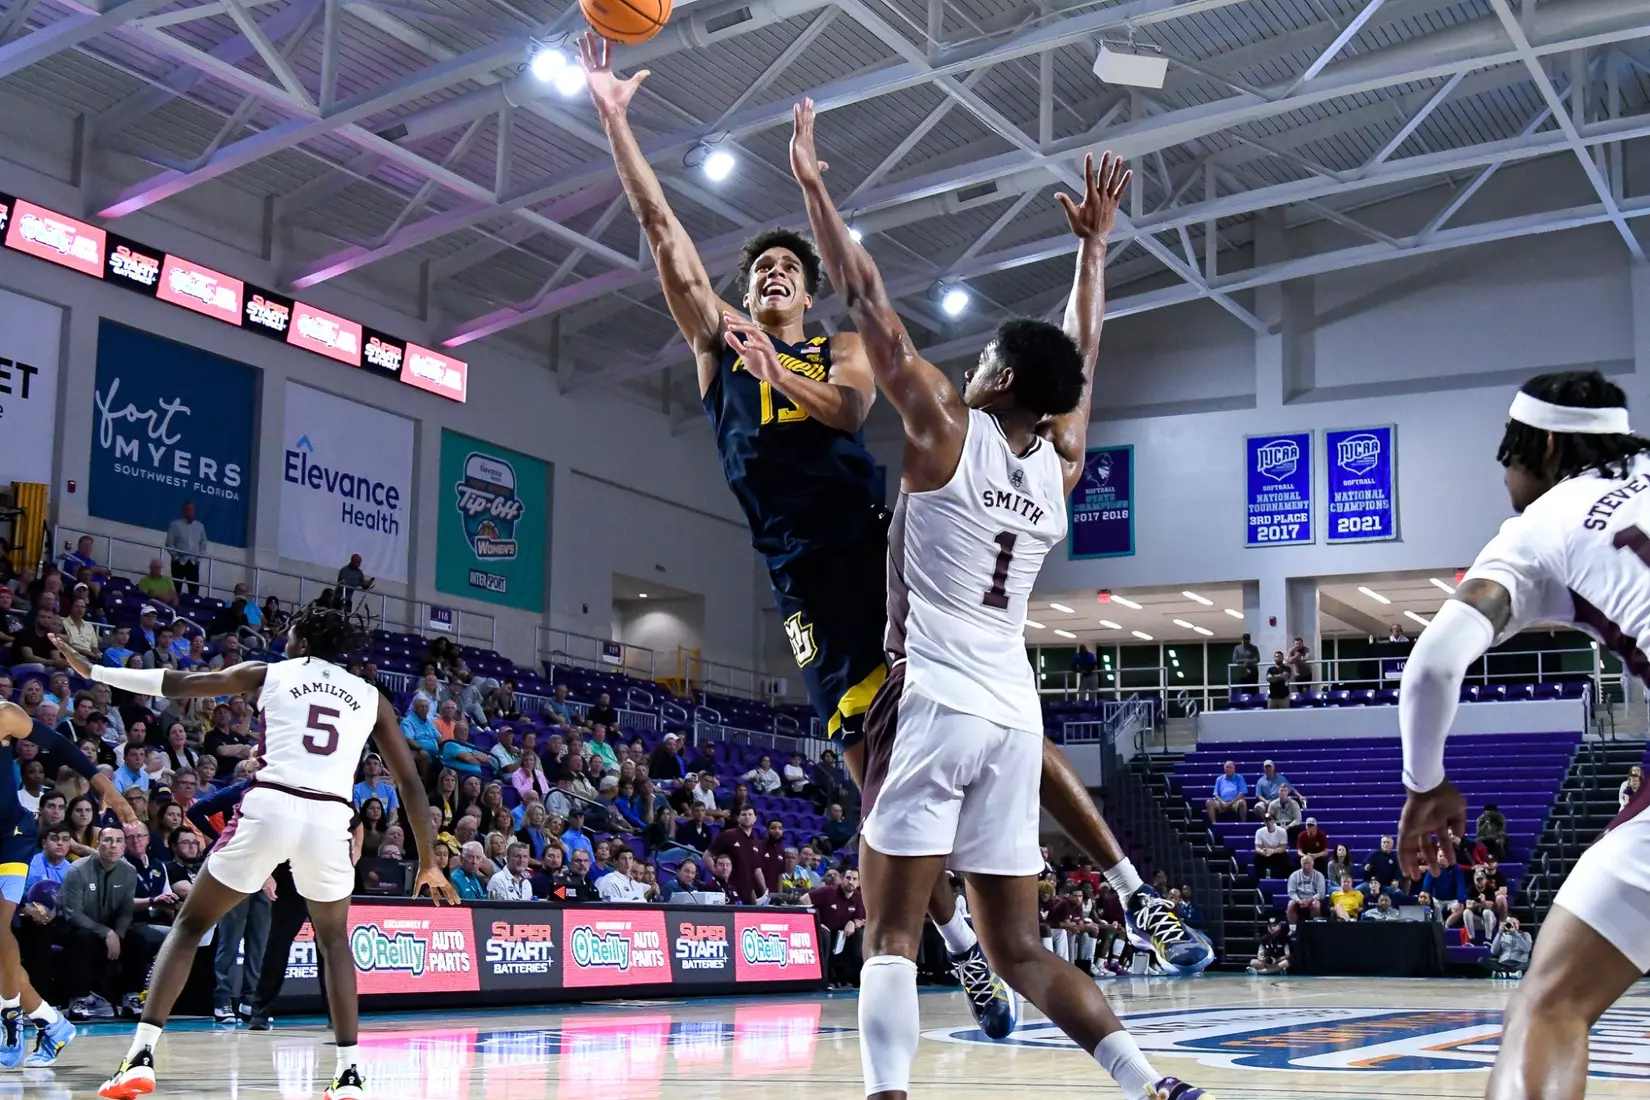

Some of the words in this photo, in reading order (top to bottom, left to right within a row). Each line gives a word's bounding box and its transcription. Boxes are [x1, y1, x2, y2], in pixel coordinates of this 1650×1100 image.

[109, 252, 159, 280] START
[246, 301, 289, 326] START
[115, 434, 242, 487] MYERS
[1257, 445, 1300, 472] NJCAA
[1338, 440, 1380, 466] NJCAA
[114, 463, 189, 488] SOUTHWEST
[193, 482, 240, 501] FLORIDA
[284, 450, 400, 510] Elevance
[1085, 486, 1115, 494] SOFTBALL
[1262, 483, 1294, 491] SOFTBALL
[1343, 478, 1375, 486] SOFTBALL
[458, 485, 520, 519] Tip-Off
[1256, 491, 1301, 503] NATIONAL
[1334, 489, 1384, 502] NATIONAL
[983, 490, 1044, 526] SMITH
[1248, 500, 1310, 513] TOURNAMENT
[1330, 499, 1389, 513] CHAMPIONS
[341, 502, 399, 536] Health
[1074, 512, 1100, 523] 2017
[1249, 515, 1271, 526] 3RD
[1273, 513, 1308, 524] PLACE
[1337, 516, 1382, 533] 2021
[1257, 524, 1300, 541] 2017
[982, 530, 1018, 610] 1
[289, 681, 362, 712] HAMILTON
[302, 703, 341, 757] 5
[431, 931, 464, 951] AUTO
[491, 921, 551, 941] SUPER
[633, 931, 659, 948] AUTO
[679, 922, 726, 940] SUPER
[790, 932, 811, 948] AUTO
[351, 925, 425, 976] O'Reilly
[485, 938, 554, 962] START
[571, 926, 630, 971] O'Reilly
[675, 938, 729, 958] START
[742, 927, 788, 968] O'Reilly
[789, 949, 816, 965] PARTS
[429, 952, 471, 972] PARTS
[493, 963, 548, 974] BATTERIES
[631, 949, 665, 968] PARTS
[682, 959, 725, 969] BATTERIES
